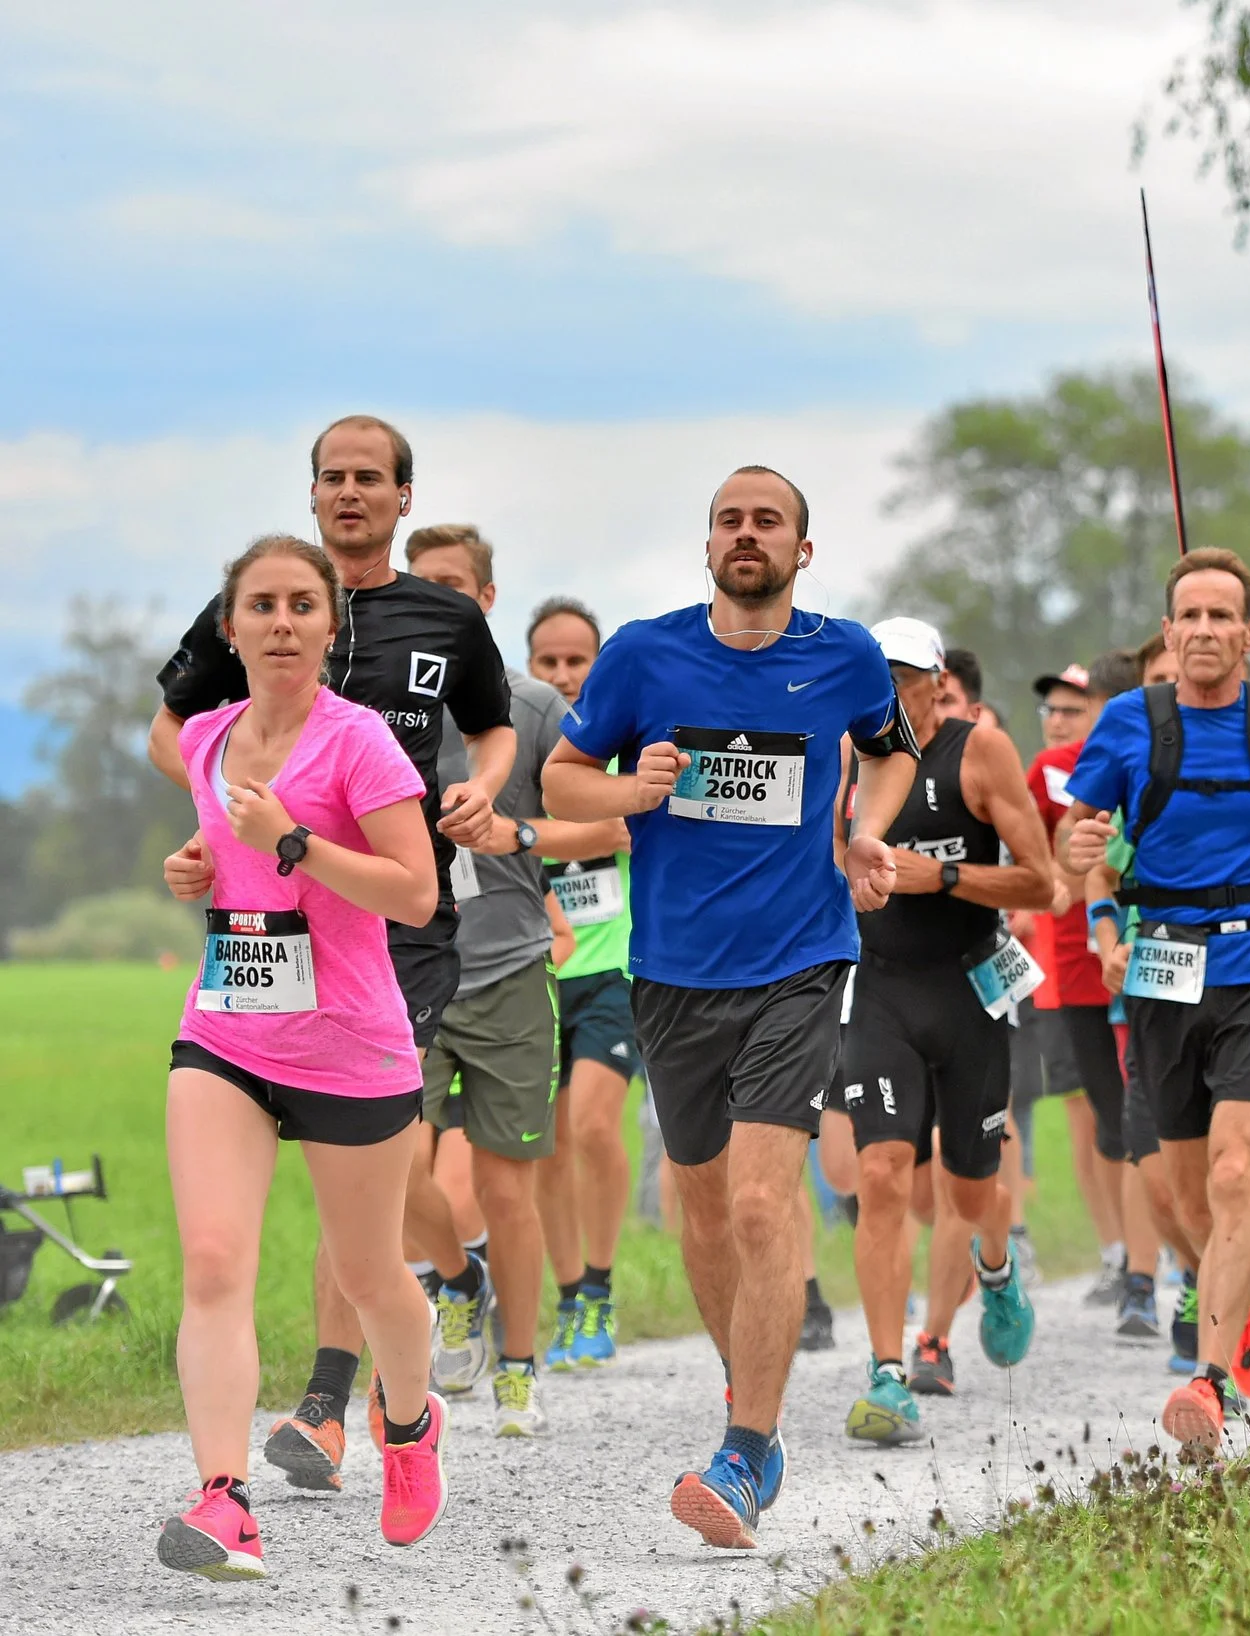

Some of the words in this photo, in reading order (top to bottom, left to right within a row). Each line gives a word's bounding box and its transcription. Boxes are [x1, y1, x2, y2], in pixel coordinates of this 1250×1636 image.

[699, 755, 778, 780] PATRICK
[704, 779, 767, 801] 2606
[720, 806, 746, 815] Zürcher
[720, 813, 767, 823] Kantonalbank
[553, 876, 597, 895] DONAT
[215, 940, 288, 963] BARBARA
[222, 965, 275, 988] 2605
[998, 957, 1030, 990] 2608
[1136, 965, 1175, 987] PETER
[878, 1076, 897, 1115] 2XU
